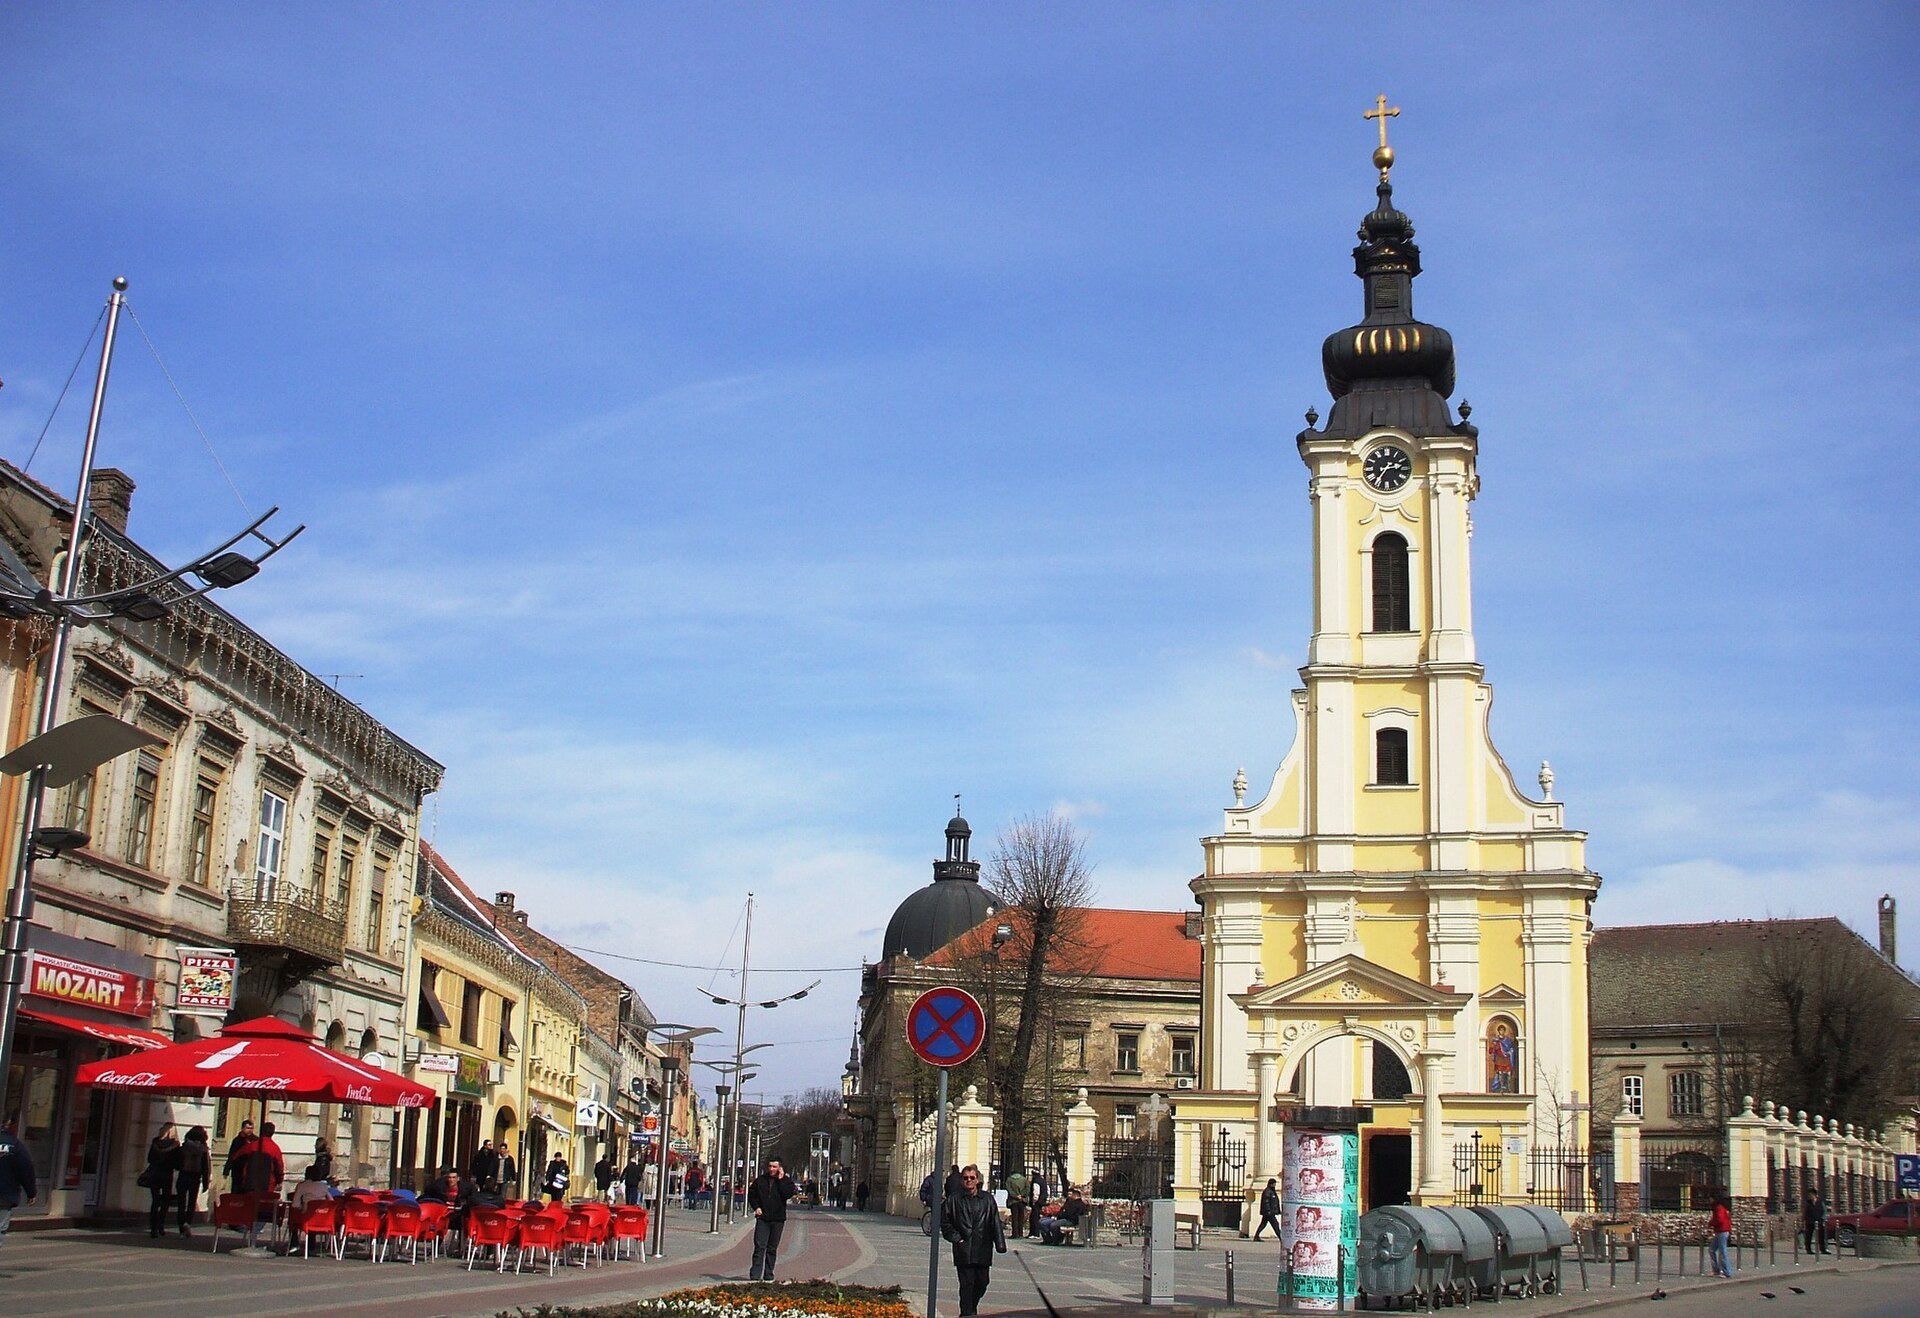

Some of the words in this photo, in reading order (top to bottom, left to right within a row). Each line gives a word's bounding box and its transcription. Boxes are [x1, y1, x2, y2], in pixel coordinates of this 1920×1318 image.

[187, 958, 230, 968] PIZZA
[37, 966, 125, 1007] MOZART
[1899, 1159, 1912, 1176] P
